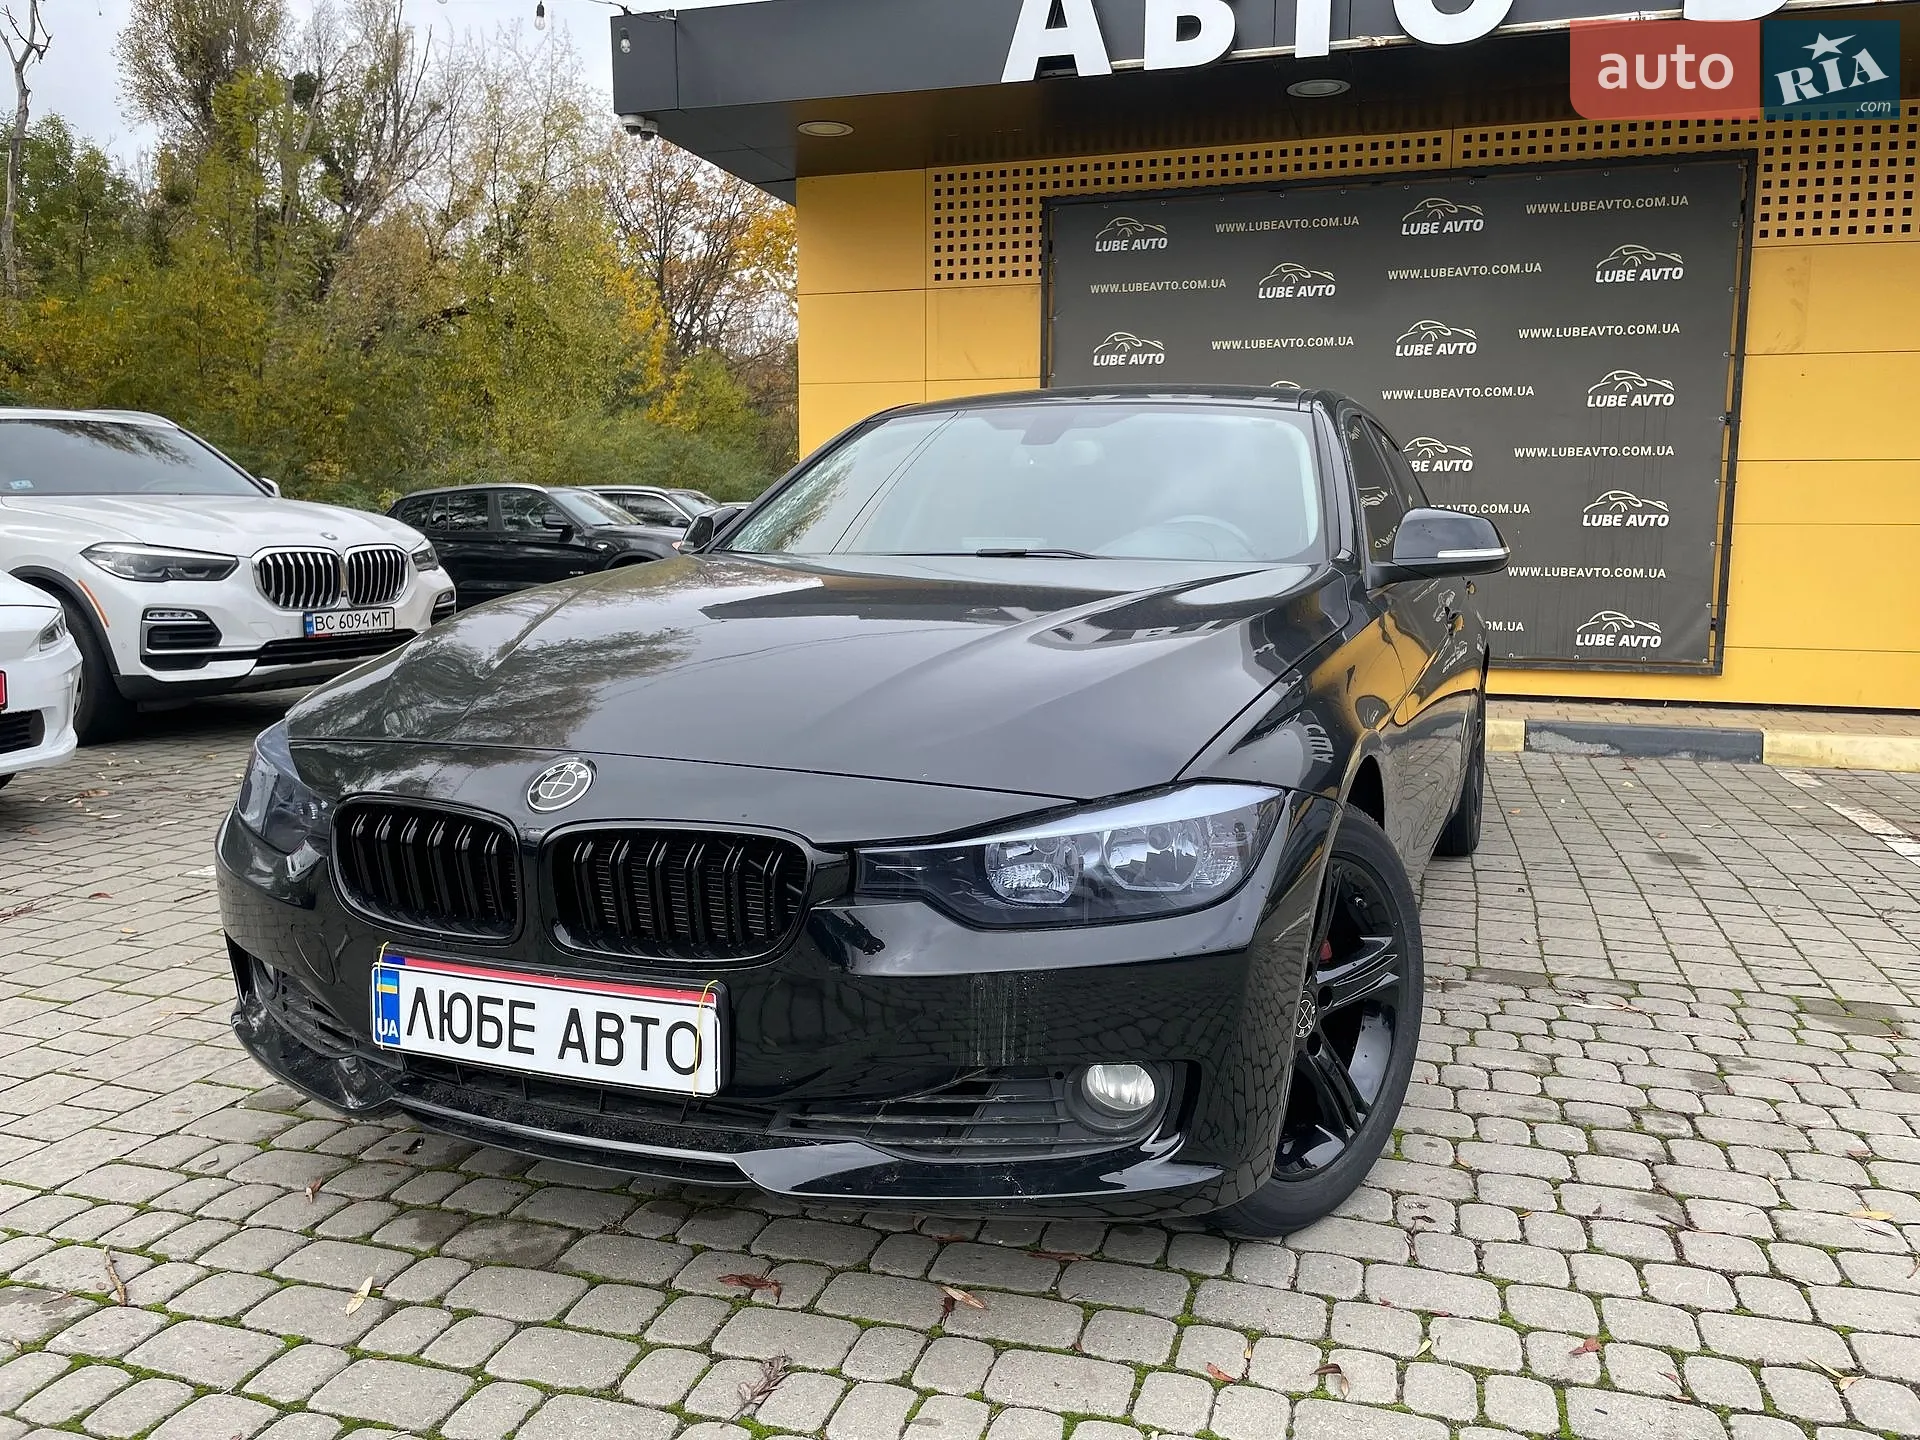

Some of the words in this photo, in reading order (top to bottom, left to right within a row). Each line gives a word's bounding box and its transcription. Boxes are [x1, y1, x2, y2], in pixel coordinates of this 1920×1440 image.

[1527, 195, 1689, 214] WWW.LUBEAVTO.COM.UA
[1215, 215, 1360, 233] WWW.LUBEAVTO.COM.UA
[1401, 221, 1439, 235] LUBE
[1442, 218, 1484, 234] AVTO
[1095, 239, 1128, 252] LUBE
[1132, 237, 1168, 251] AVTO
[1388, 262, 1542, 280] WWW.LUBEAVTO.COM.UA
[1595, 268, 1636, 283] LUBE
[1639, 266, 1684, 282] AVTO
[1090, 278, 1227, 294] WWW.LUBEAVTO.COM.UA
[1258, 286, 1293, 299] LUBE
[1296, 284, 1336, 297] AVTO
[1518, 323, 1680, 339] WWW.LUBEAVTO.COM.UA
[1211, 336, 1354, 350] WWW.LUBEAVTO.COM.UA
[1395, 344, 1433, 357] LUBE
[1436, 342, 1477, 355] AVTO
[1093, 354, 1126, 366] LUBE
[1129, 352, 1165, 365] AVTO
[1382, 385, 1535, 400] WWW.LUBEAVTO.COM.UA
[1586, 393, 1627, 408] LUBE
[1630, 392, 1675, 407] AVTO
[1514, 445, 1675, 458] WWW.LUBEAVTO.COM.UA
[1408, 460, 1430, 473] BE
[1433, 459, 1473, 472] AVTO
[1582, 514, 1622, 527] LUBE
[1625, 513, 1670, 527] AVTO
[1507, 566, 1667, 579] WWW.LUBEAVTO.COM.UA
[314, 615, 335, 631] BC
[339, 613, 369, 629] 6094
[371, 611, 390, 627] MT
[1575, 633, 1616, 647] LUBE
[1618, 634, 1662, 648] AVTO
[377, 1017, 399, 1038] UA
[407, 986, 535, 1056] ЛЮБЕ
[557, 1007, 703, 1076] АВТО
